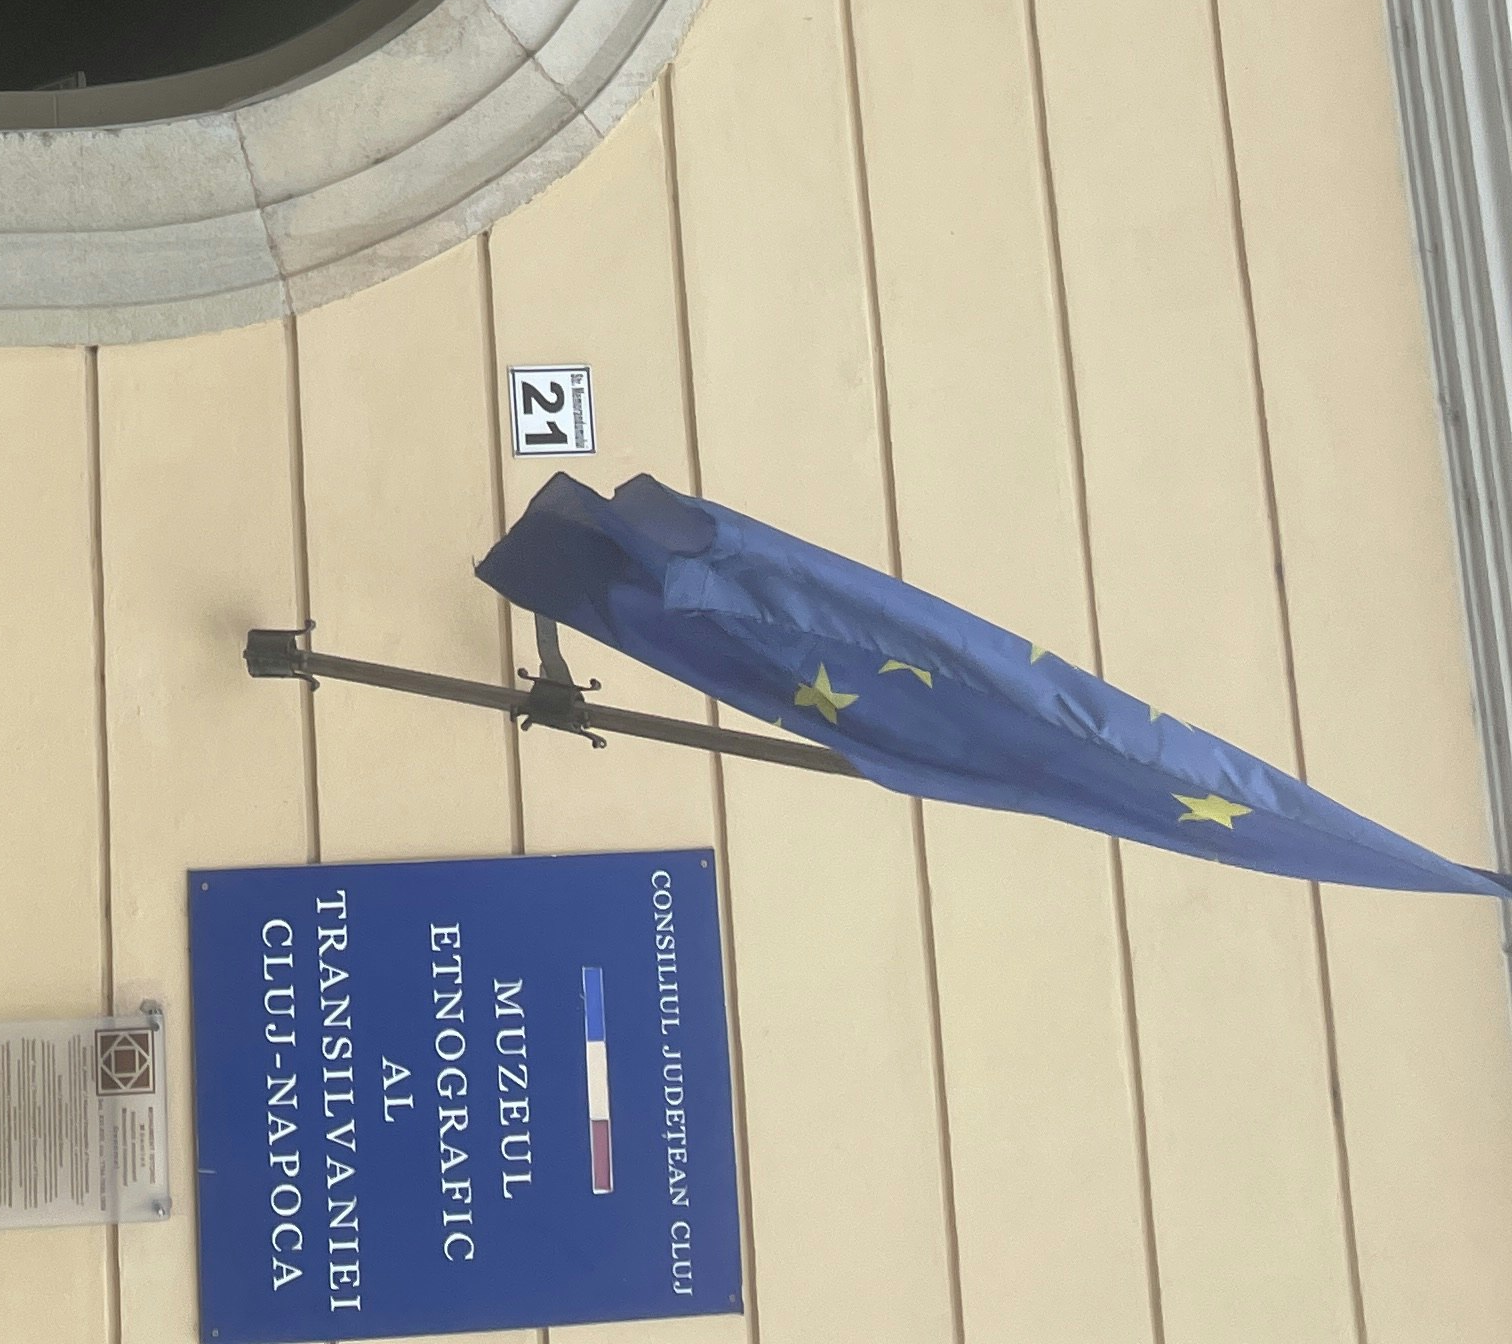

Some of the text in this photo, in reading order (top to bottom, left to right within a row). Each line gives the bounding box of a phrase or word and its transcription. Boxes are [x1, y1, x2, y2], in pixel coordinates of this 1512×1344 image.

[521, 381, 568, 445] 21
[262, 918, 304, 1291] CLUJ-NAPOCA
[315, 890, 362, 1312] TRANSILVANIEI
[381, 1056, 414, 1122] AL
[430, 923, 475, 1262] ETNOGRAFIC
[493, 978, 532, 1200] MUZEUL
[651, 870, 681, 1035] CONSILIUL
[671, 1221, 694, 1296] CLUJ
